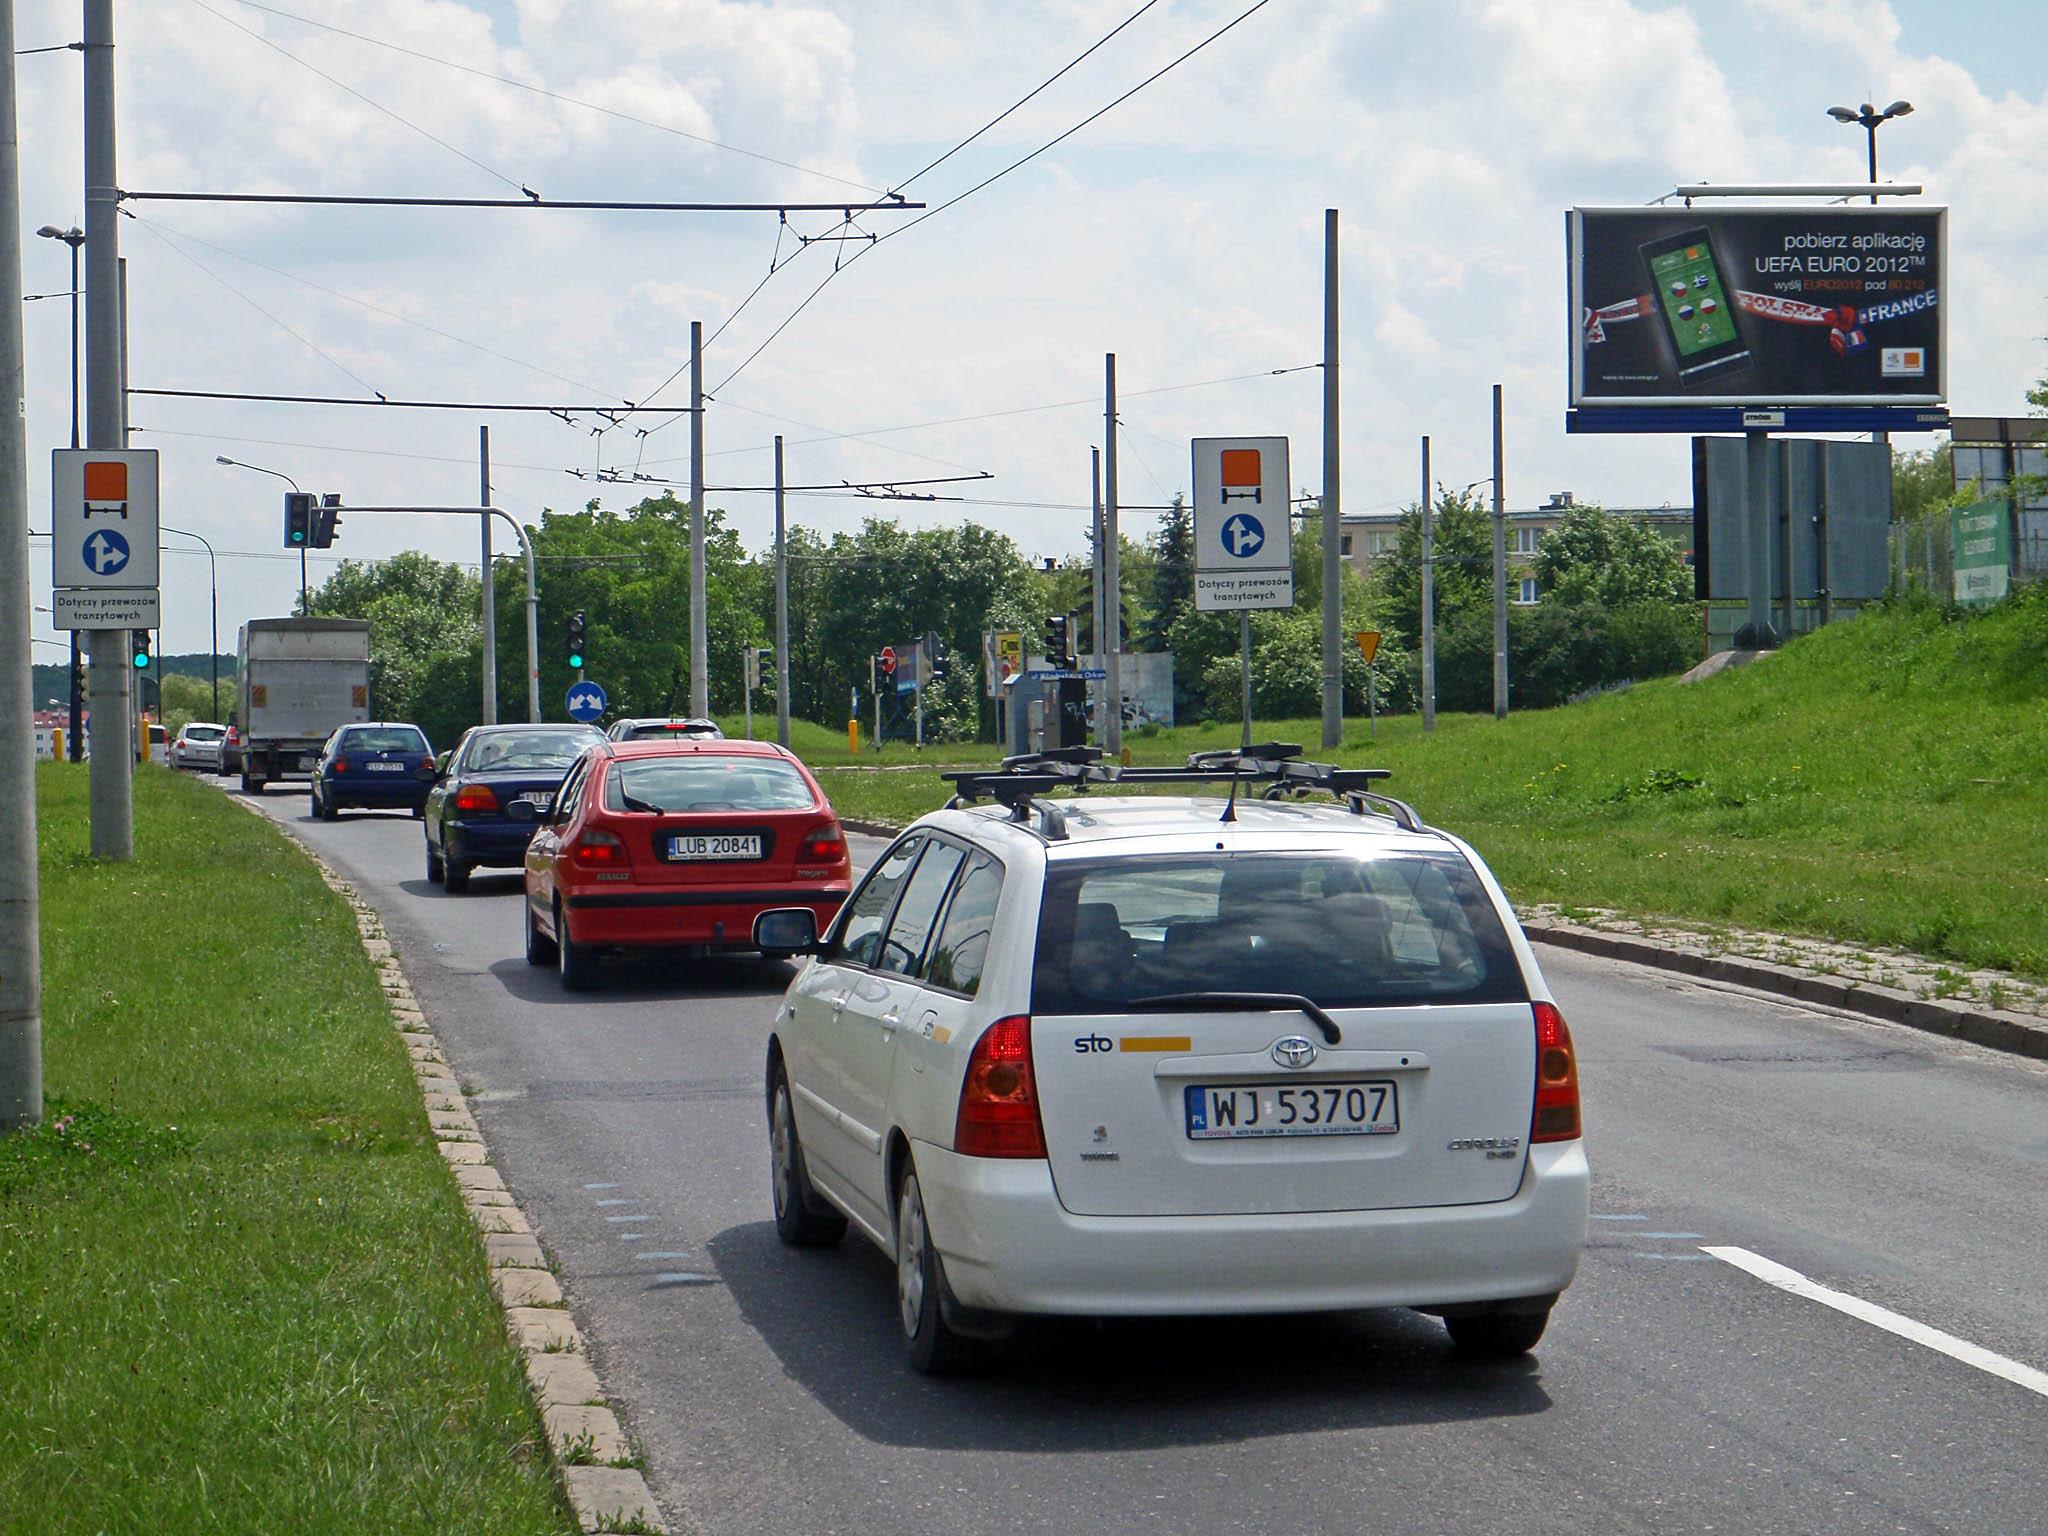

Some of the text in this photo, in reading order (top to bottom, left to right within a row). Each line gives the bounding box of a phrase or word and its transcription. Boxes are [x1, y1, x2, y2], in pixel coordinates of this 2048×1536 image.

[1783, 232, 1926, 252] pobierz aplikację
[1755, 257, 1804, 273] UEFA
[1807, 256, 1861, 273] EURO
[1864, 279, 1886, 291] pod
[1740, 293, 1825, 319] POLSKA
[1867, 288, 1937, 322] FRANCE
[1198, 577, 1290, 590] Dotyczy przewozów
[58, 597, 97, 608] Dotyczy
[1213, 591, 1276, 602] tranzytowych
[73, 611, 141, 622] tranzytowych
[677, 837, 757, 854] LUB 20841
[1074, 1032, 1113, 1053] sto
[1213, 1086, 1387, 1127] WJ 53707
[1192, 1114, 1205, 1125] PL
